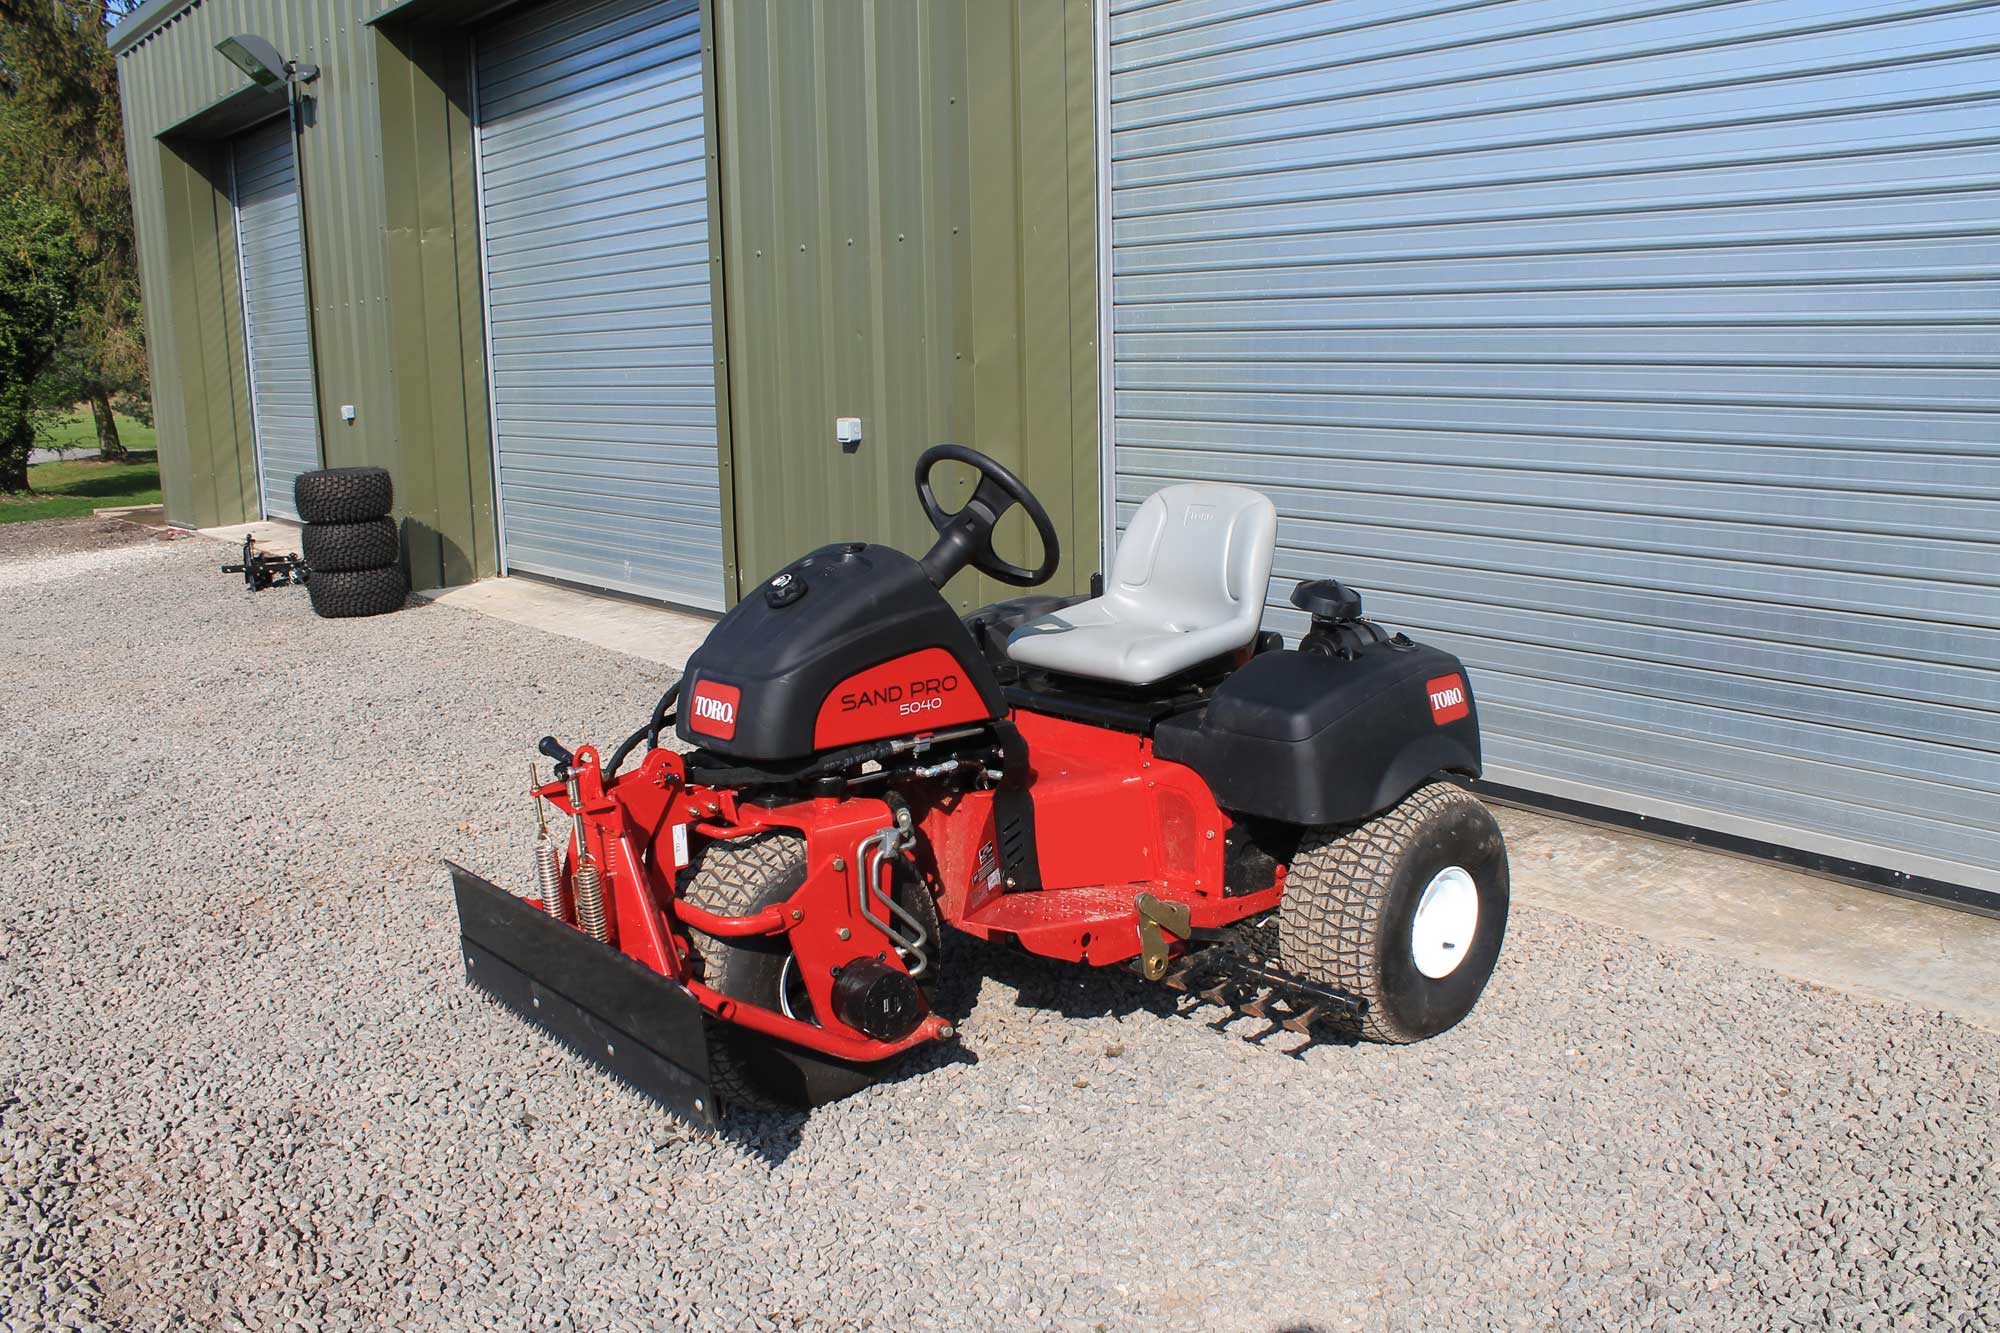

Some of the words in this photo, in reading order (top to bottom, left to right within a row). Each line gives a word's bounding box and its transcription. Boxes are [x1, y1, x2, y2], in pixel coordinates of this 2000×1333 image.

[841, 685, 903, 712] SAND
[910, 675, 958, 697] PRO
[899, 697, 942, 716] 5040
